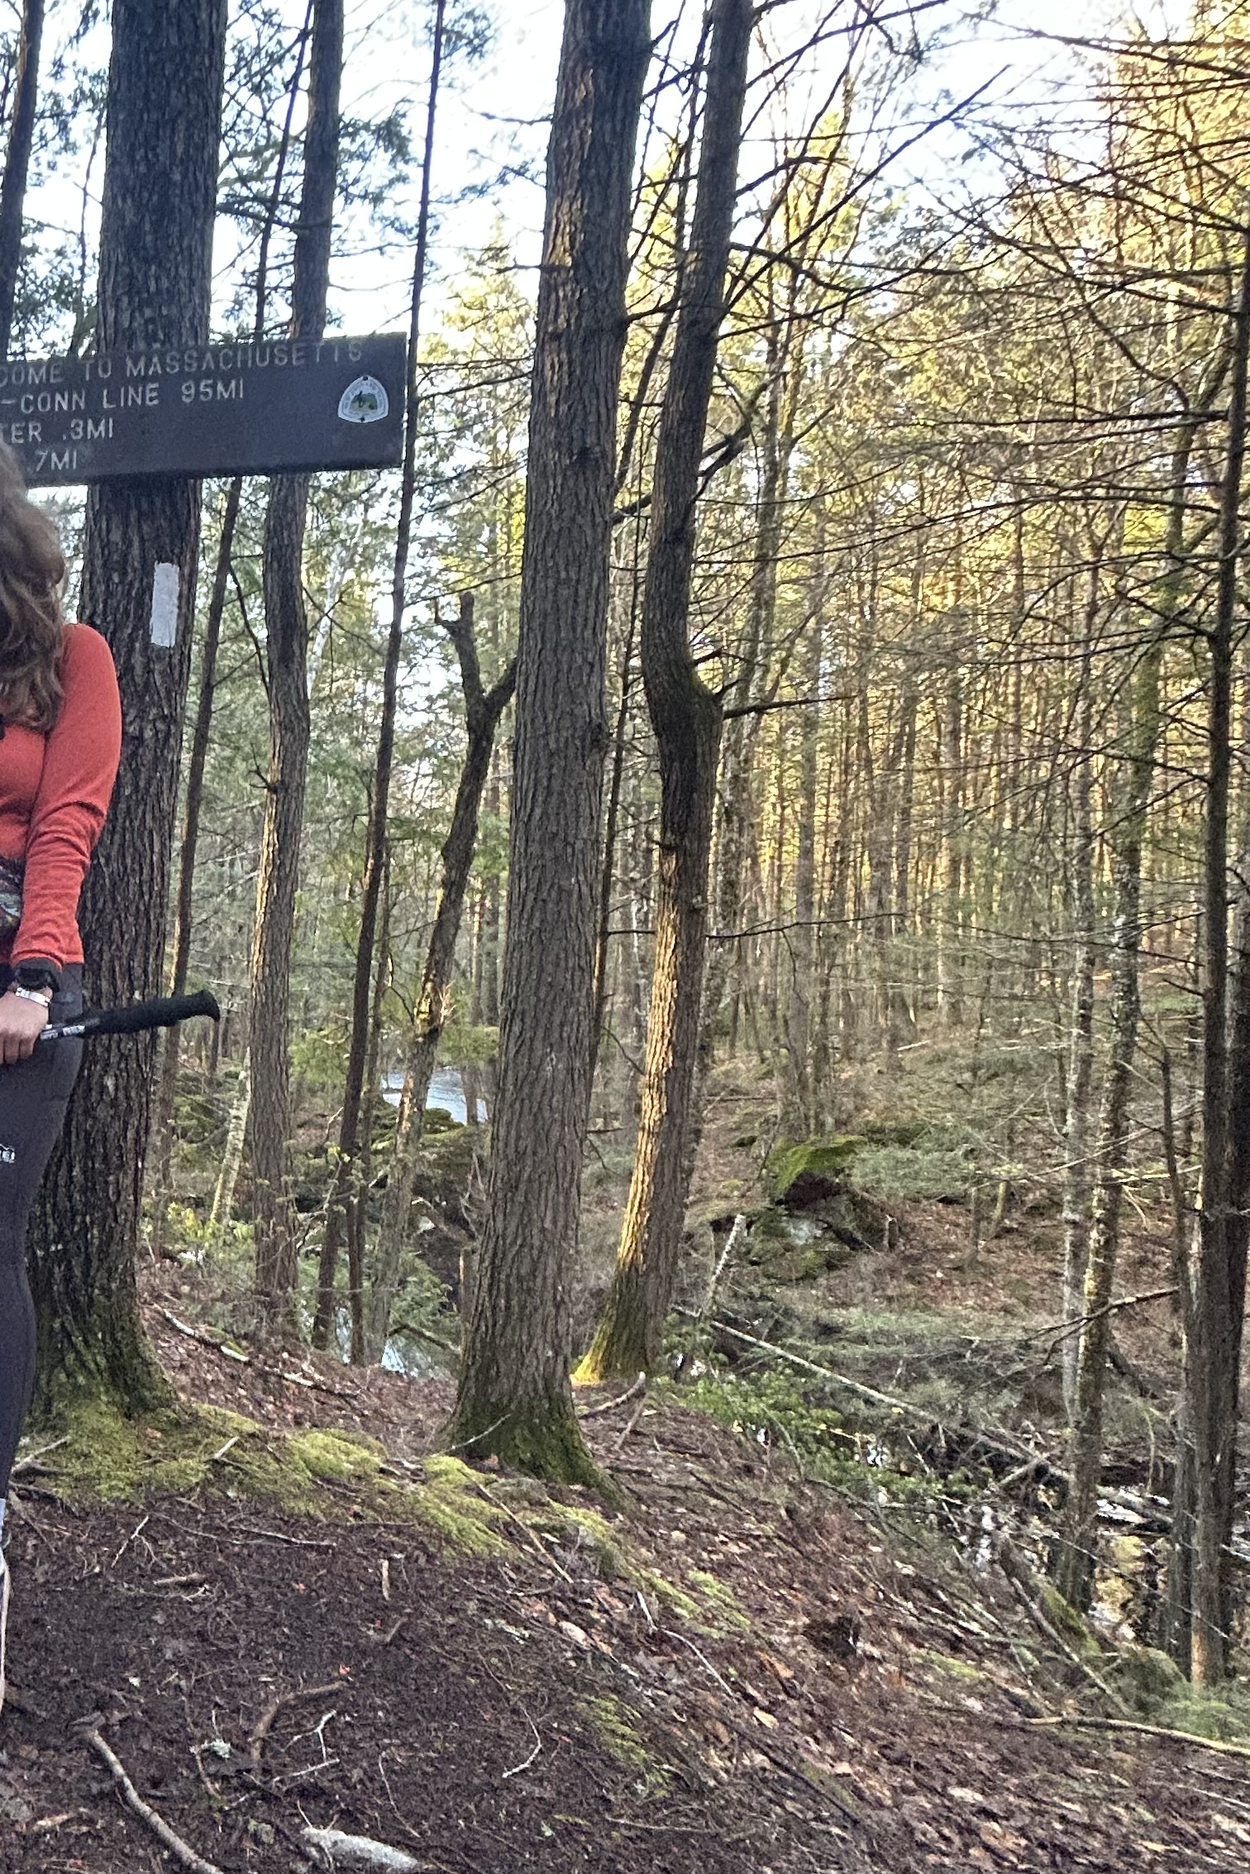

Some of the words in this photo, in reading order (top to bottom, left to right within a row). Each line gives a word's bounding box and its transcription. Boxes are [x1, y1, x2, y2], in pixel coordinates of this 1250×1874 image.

[82, 358, 112, 382] TO
[126, 341, 362, 377] MASSACHUSETTS
[103, 382, 160, 409] LINE
[181, 377, 245, 404] 95MI
[63, 418, 114, 441] .3MI
